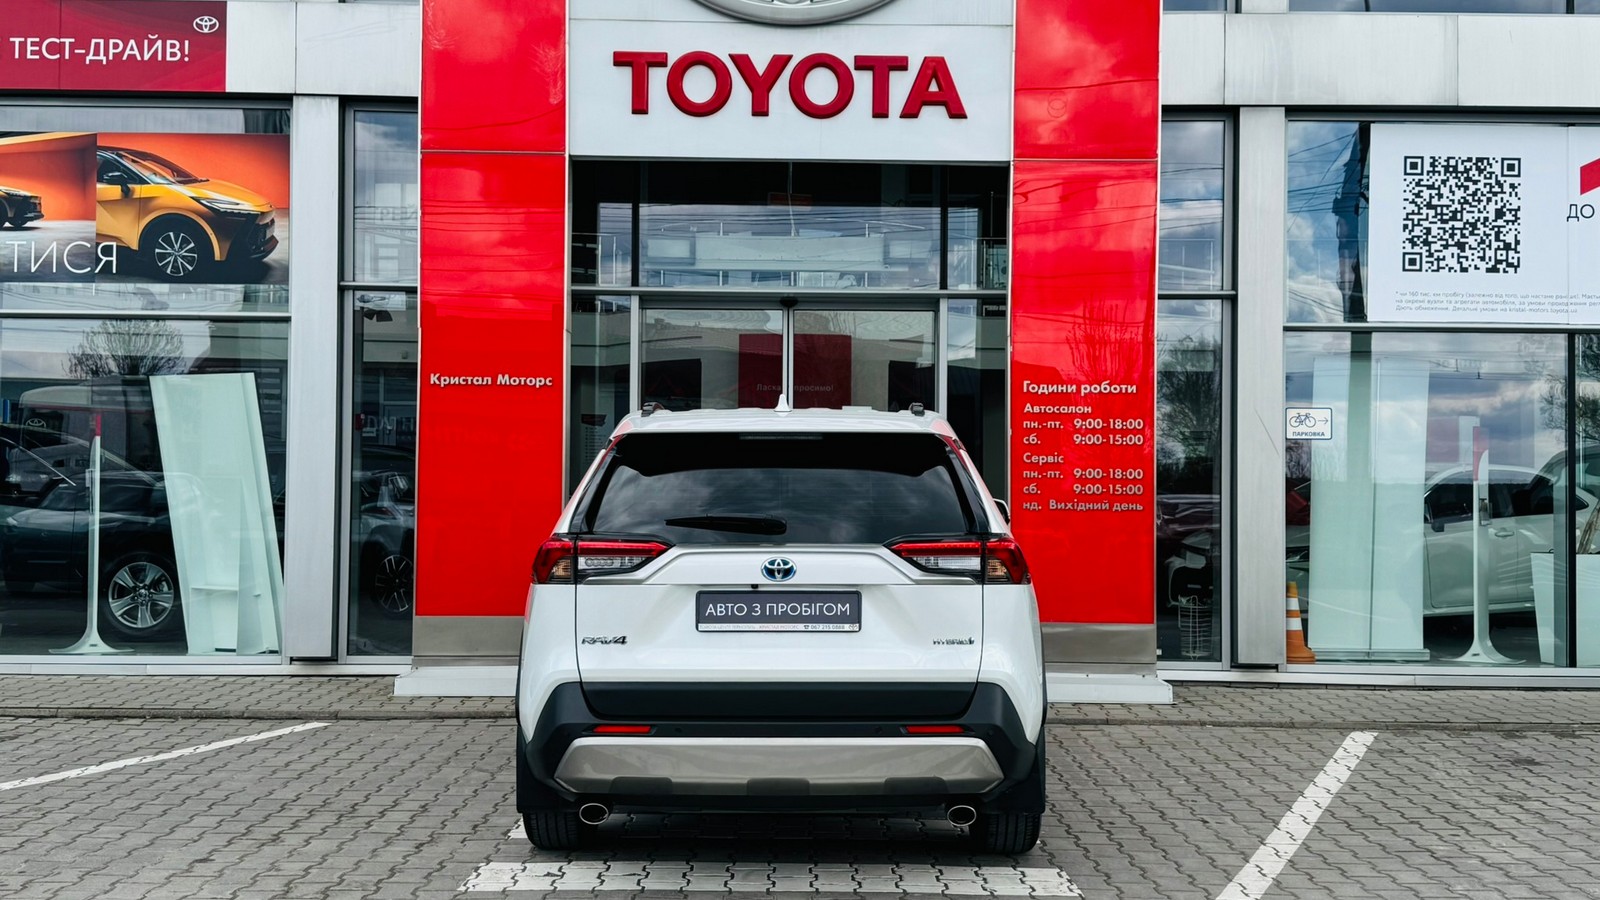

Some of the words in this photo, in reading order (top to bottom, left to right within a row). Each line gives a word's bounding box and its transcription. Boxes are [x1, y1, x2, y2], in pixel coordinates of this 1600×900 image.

[9, 34, 190, 64] ТЕСТ-ДРАЙВ!
[613, 50, 968, 119] TOYOTA
[1566, 203, 1595, 222] ДО
[5, 240, 117, 274] ТИСЯ
[430, 373, 492, 387] Кристал
[496, 374, 553, 388] Моторс
[1023, 380, 1077, 395] Години
[1080, 380, 1137, 397] роботи
[1023, 403, 1092, 414] Автосалон
[1023, 420, 1064, 429] пн.-пт.
[1073, 418, 1144, 430] 9:00-18:00
[1023, 433, 1041, 445] сб.
[1073, 434, 1144, 445] 9:00-15:00
[1023, 452, 1064, 466] Сервіс
[1023, 470, 1064, 479] пн.-пт.
[1073, 468, 1144, 480] 9:00-18:00
[1023, 483, 1041, 494] сб.
[1073, 483, 1144, 495] 9:00-15:00
[1023, 502, 1042, 511] нд.
[1049, 499, 1109, 511] Вихідний
[1113, 503, 1143, 511] день
[705, 603, 748, 616] АВТО
[751, 603, 761, 616] З
[766, 603, 850, 616] ПРОБІГОМ
[581, 635, 628, 645] RAV4
